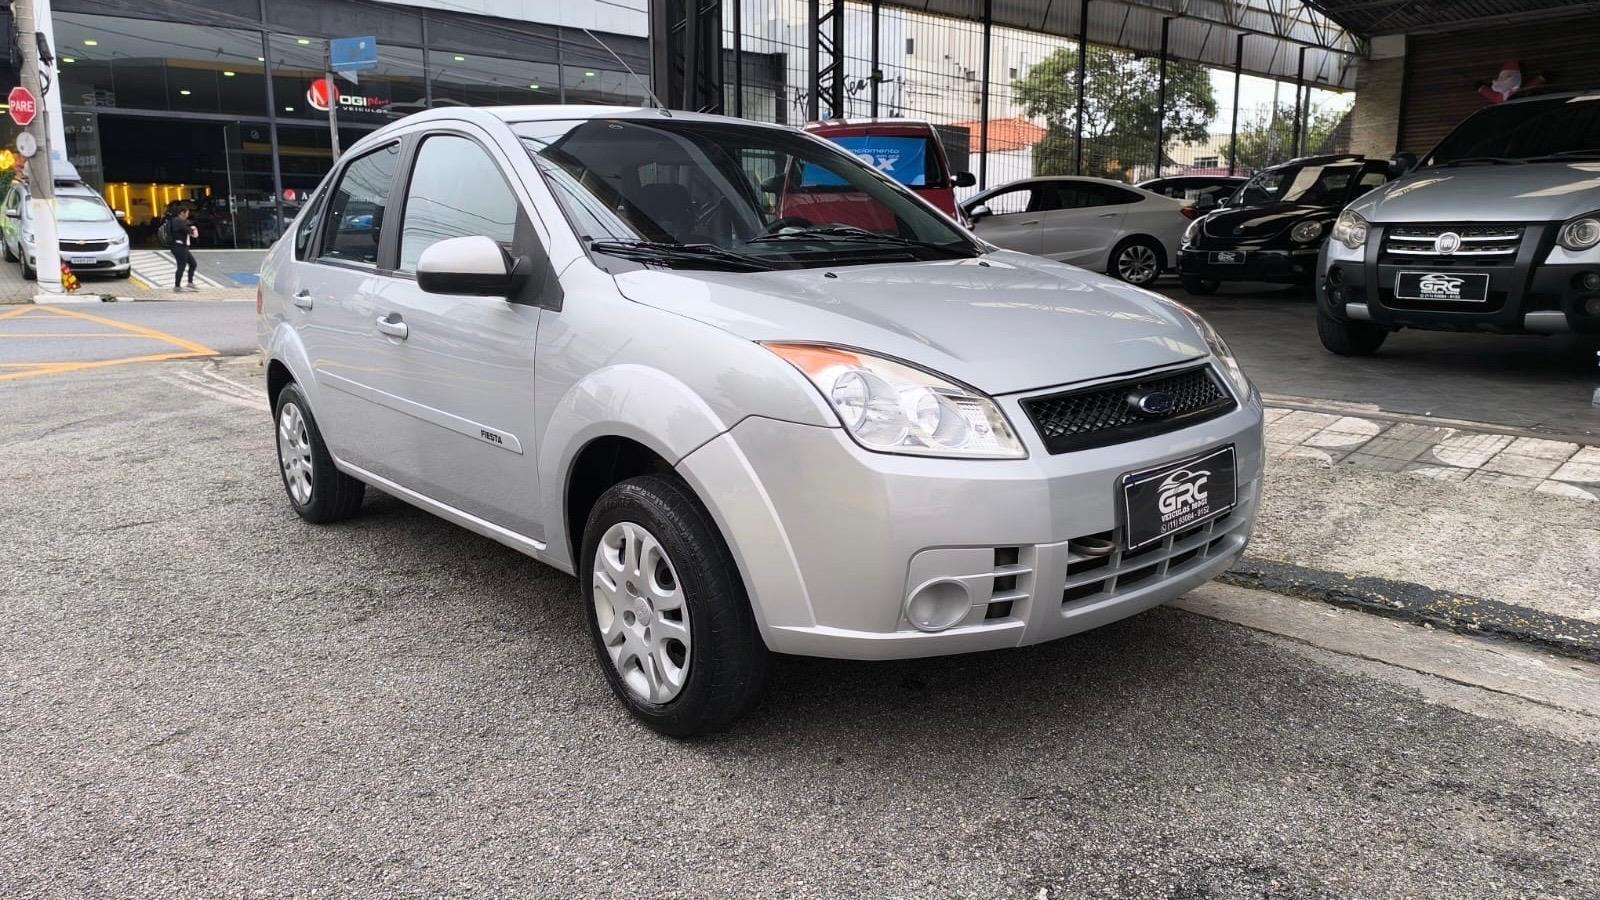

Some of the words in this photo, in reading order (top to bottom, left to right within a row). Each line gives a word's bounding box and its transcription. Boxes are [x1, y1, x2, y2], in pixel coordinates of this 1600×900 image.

[10, 100, 34, 112] PARE
[1419, 280, 1461, 292] GRC
[480, 429, 503, 444] FIESTA
[1158, 476, 1208, 514] GRC
[1161, 505, 1190, 522] VEICULOS
